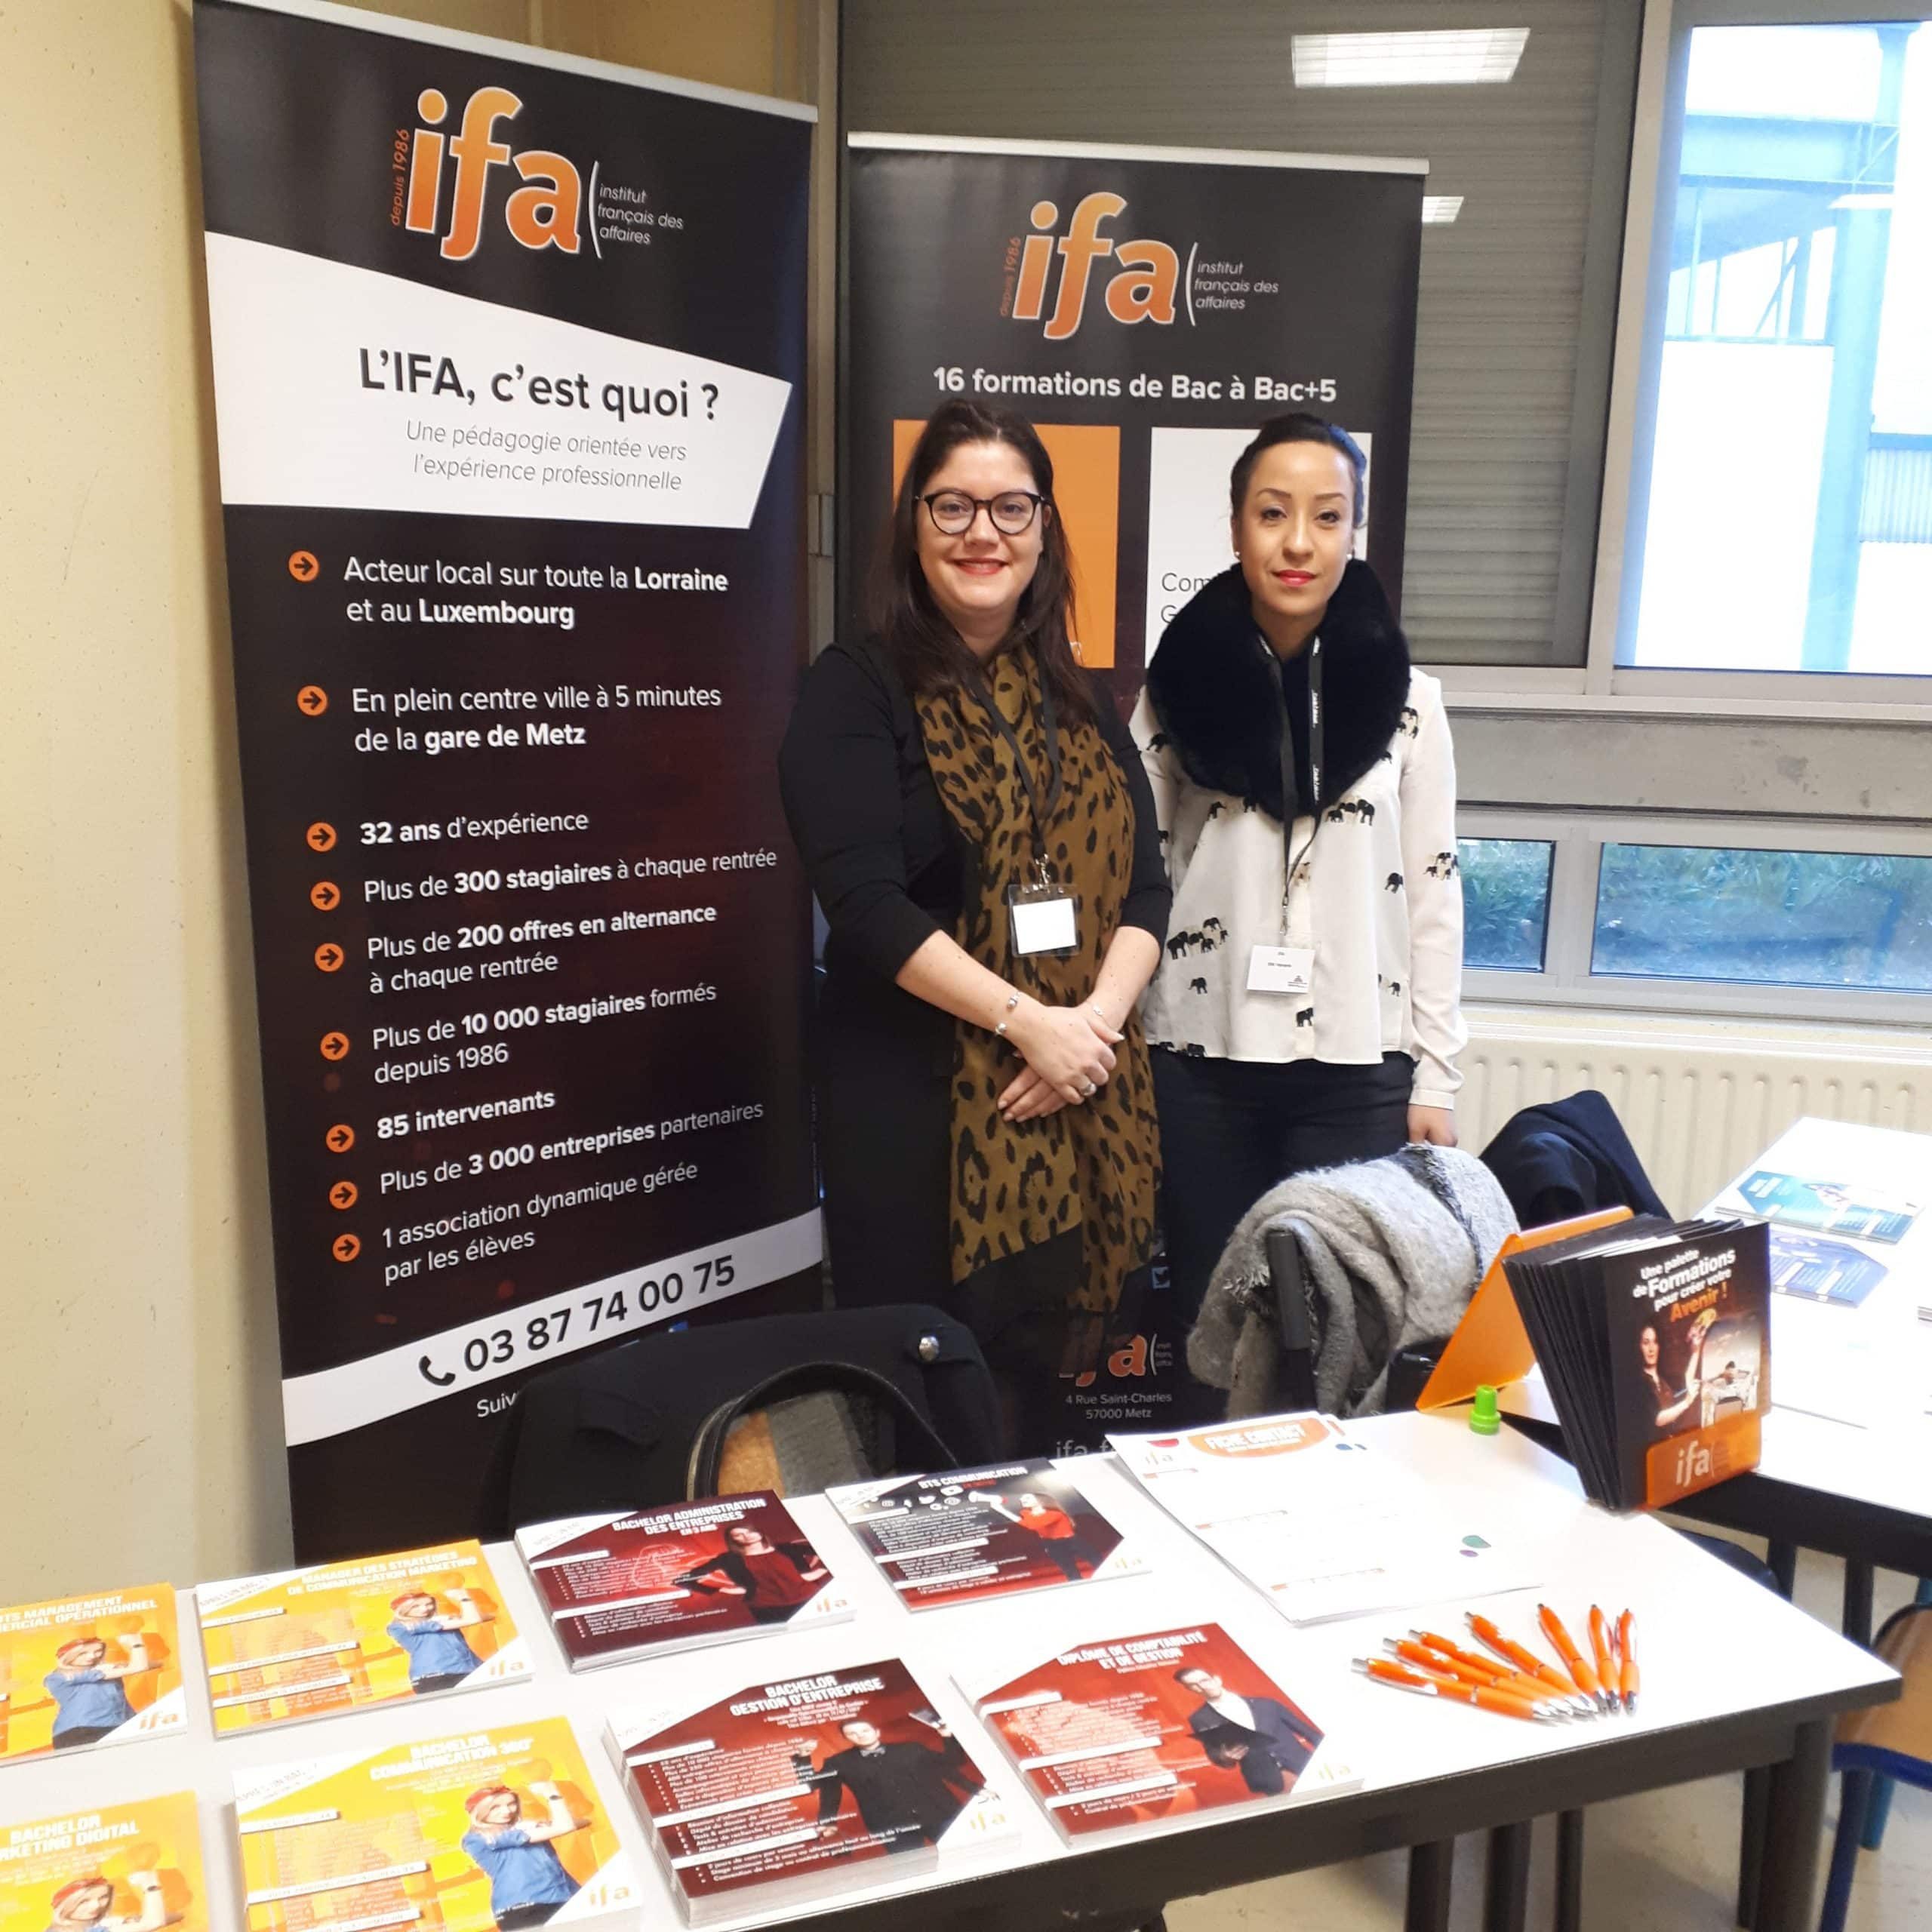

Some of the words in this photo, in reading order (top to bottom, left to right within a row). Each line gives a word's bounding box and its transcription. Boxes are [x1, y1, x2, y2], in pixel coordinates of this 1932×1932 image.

[395, 128, 411, 171] 1986
[405, 86, 582, 260] ifa
[390, 175, 405, 227] depuis
[598, 183, 647, 204] institut
[597, 202, 655, 228] français
[657, 212, 684, 231] des
[598, 223, 651, 245] affaires
[1005, 237, 1021, 273] 1986
[1012, 192, 1180, 340] ifa
[1197, 260, 1244, 276] institut
[1193, 277, 1251, 294] français
[1254, 278, 1279, 295] des
[1195, 295, 1246, 311] affaires
[602, 380, 688, 421] quoi
[702, 383, 719, 420] ?
[934, 368, 965, 392] 16
[972, 368, 1121, 398] formations
[1129, 374, 1163, 398] de
[1172, 377, 1221, 400] Bac
[1229, 374, 1245, 401] à
[1254, 377, 1337, 403] Bac+5
[406, 420, 447, 445] Une
[452, 423, 562, 455] pédagogie
[567, 433, 641, 460] orientée
[647, 442, 687, 461] vers
[542, 463, 683, 491] professionnelle
[344, 556, 429, 583] Acteur
[436, 560, 492, 586] local
[500, 565, 537, 587] sur
[545, 565, 603, 589] toute
[609, 566, 628, 589] la
[635, 568, 728, 592] Lorraine
[346, 599, 373, 622] et
[380, 601, 411, 622] au
[419, 599, 575, 629] Luxembourg
[352, 688, 385, 713] En
[394, 688, 454, 716] plein
[460, 688, 537, 711] centre
[544, 685, 590, 709] ville
[596, 685, 609, 708] à
[615, 687, 629, 707] 5
[636, 685, 721, 707] minutes
[355, 728, 388, 752] de
[396, 726, 417, 750] la
[424, 728, 481, 755] gare
[488, 724, 519, 747] de
[526, 723, 586, 746] Metz
[361, 821, 392, 845] 32
[400, 820, 441, 841] ans
[364, 877, 414, 903] Plus
[420, 874, 449, 897] de
[454, 870, 500, 893] 300
[507, 862, 611, 894] stagiaires
[617, 859, 628, 879] à
[635, 854, 706, 884] chaque
[712, 848, 777, 872] rentrée
[368, 934, 416, 958] Plus
[423, 931, 451, 953] de
[457, 924, 503, 949] 200
[509, 918, 574, 944] offres
[580, 918, 605, 936] en
[611, 905, 716, 933] alternance
[370, 972, 383, 994] à
[391, 964, 472, 992] chaque
[481, 952, 558, 978] rentrée
[373, 1025, 422, 1050] Plus
[427, 1020, 456, 1042] de
[462, 1014, 488, 1035] 10
[494, 1006, 540, 1030] 000
[546, 993, 646, 1025] stagiaires
[651, 982, 716, 1008] formés
[375, 1056, 451, 1084] depuis
[457, 1043, 509, 1068] 1986
[377, 1116, 409, 1139] 85
[415, 1091, 555, 1134] intervenants
[380, 1167, 427, 1194] Plus
[433, 1161, 462, 1183] de
[468, 1155, 483, 1174] 3
[489, 1144, 534, 1171] 000
[540, 1122, 655, 1160] entreprises
[660, 1103, 763, 1139] partenaires
[383, 1228, 392, 1247] 1
[398, 1200, 521, 1245] association
[527, 1174, 638, 1217] dynamique
[643, 1161, 698, 1194] gérée
[385, 1257, 422, 1284] par
[428, 1250, 460, 1272] les
[466, 1230, 536, 1261] élèves
[1633, 1284, 1647, 1297] de
[1647, 1250, 1736, 1297] Formations
[1641, 1265, 1663, 1280] Une
[464, 1330, 515, 1373] 03
[528, 1309, 572, 1351] 87
[583, 1291, 628, 1334] 74
[638, 1272, 684, 1312] 00
[693, 1255, 735, 1295] 75
[1671, 1287, 1718, 1322] Avenir
[1075, 1395, 1097, 1404] Rue
[1100, 1392, 1172, 1404] Saint-Charles
[1086, 1408, 1121, 1419] 57000
[1125, 1408, 1152, 1417] Metz
[1676, 1440, 1709, 1487] ifa
[612, 1512, 672, 1531] BACHELOR
[674, 1498, 767, 1521] ADMINISTRATION
[645, 1522, 669, 1535] DES
[669, 1511, 745, 1531] ENTREPRISES
[765, 1675, 837, 1697] BACHELOR
[730, 1697, 789, 1716] GESTION
